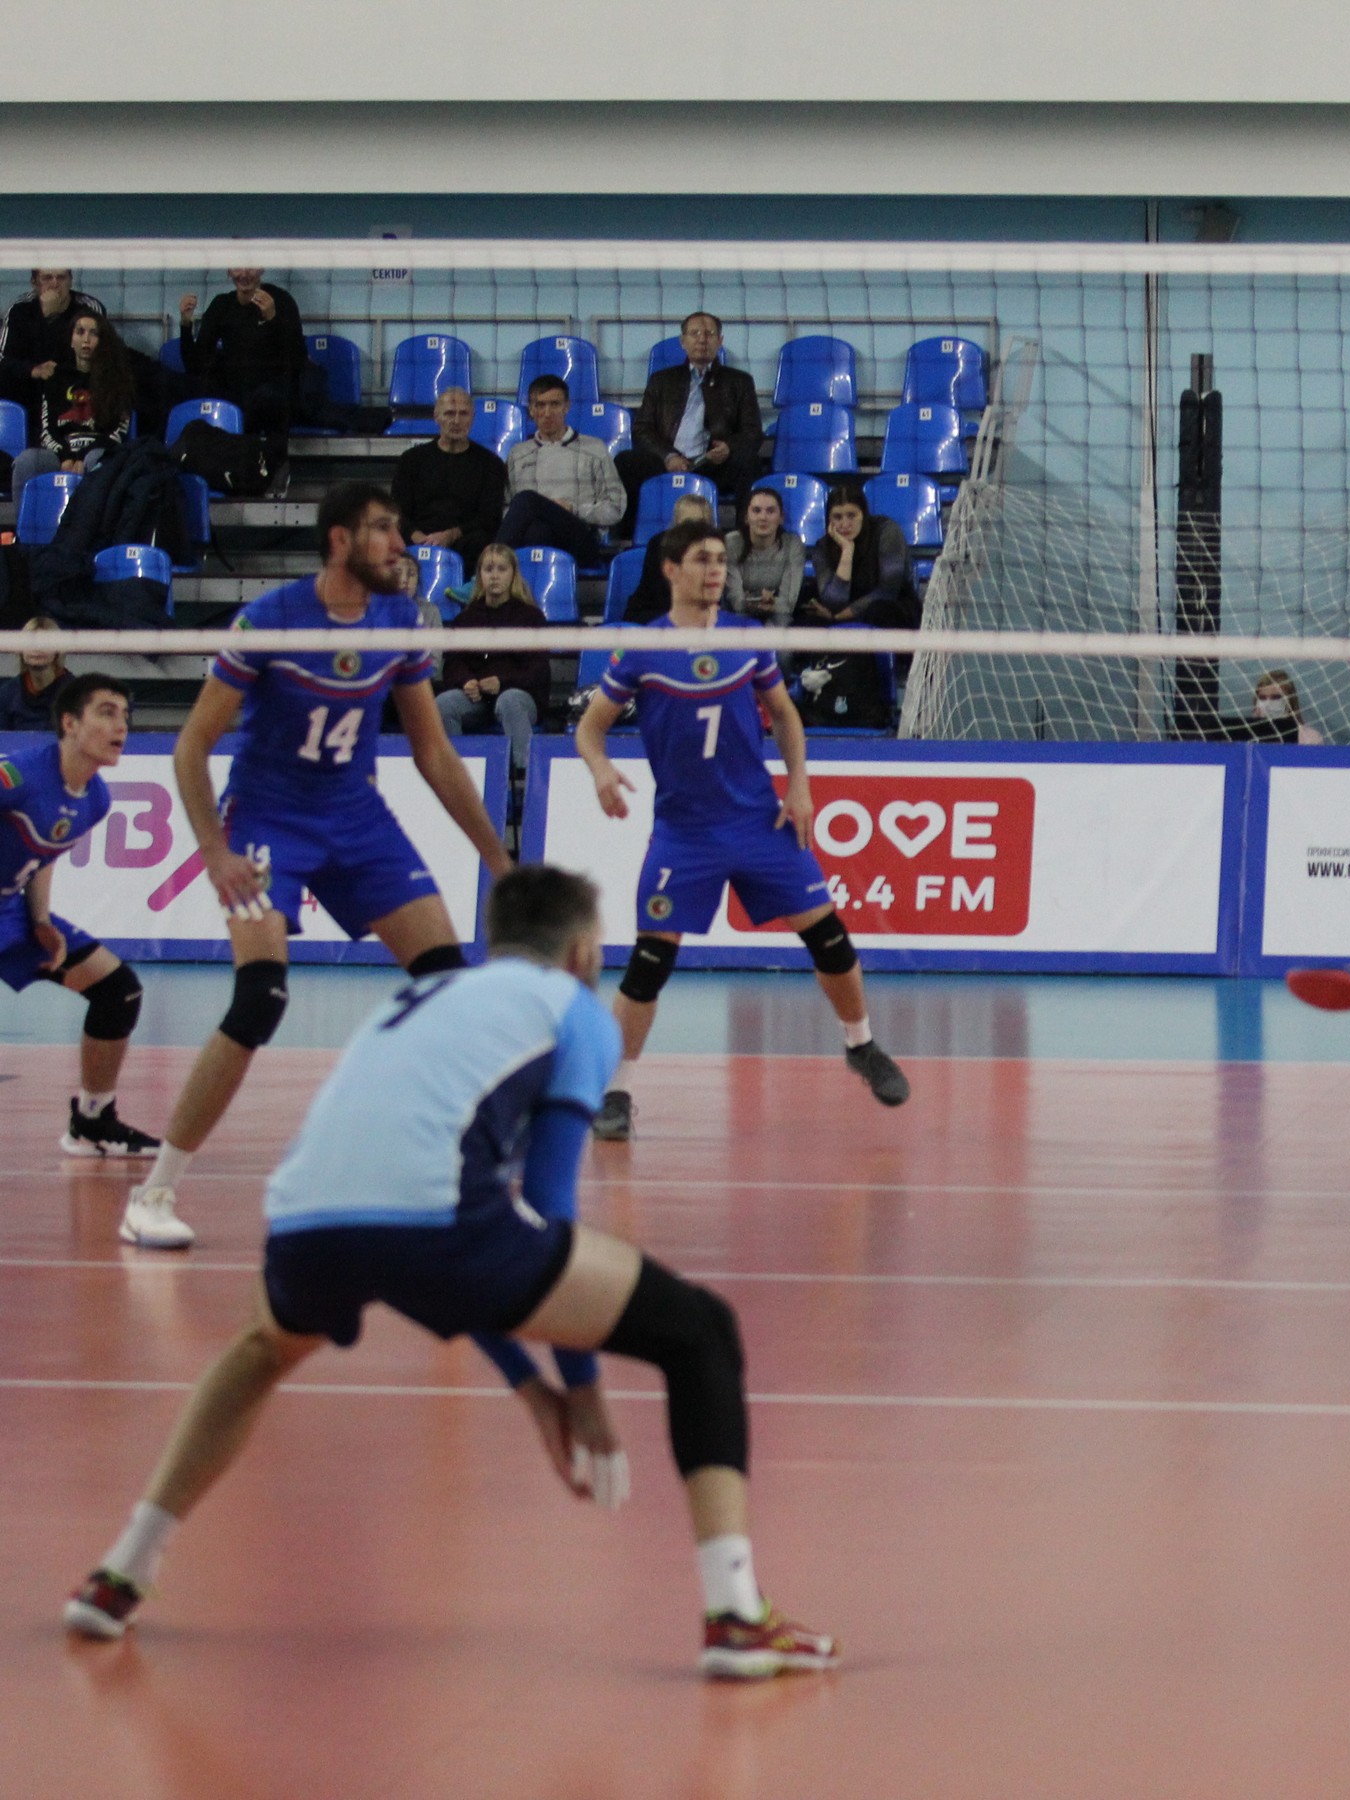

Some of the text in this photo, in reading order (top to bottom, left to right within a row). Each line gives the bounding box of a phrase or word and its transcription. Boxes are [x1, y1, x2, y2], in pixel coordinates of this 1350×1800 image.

[372, 268, 408, 279] СЕКТОР
[297, 705, 364, 765] 14
[696, 704, 722, 760] 7
[658, 867, 672, 890] 7
[829, 874, 996, 913] 4.4 FM
